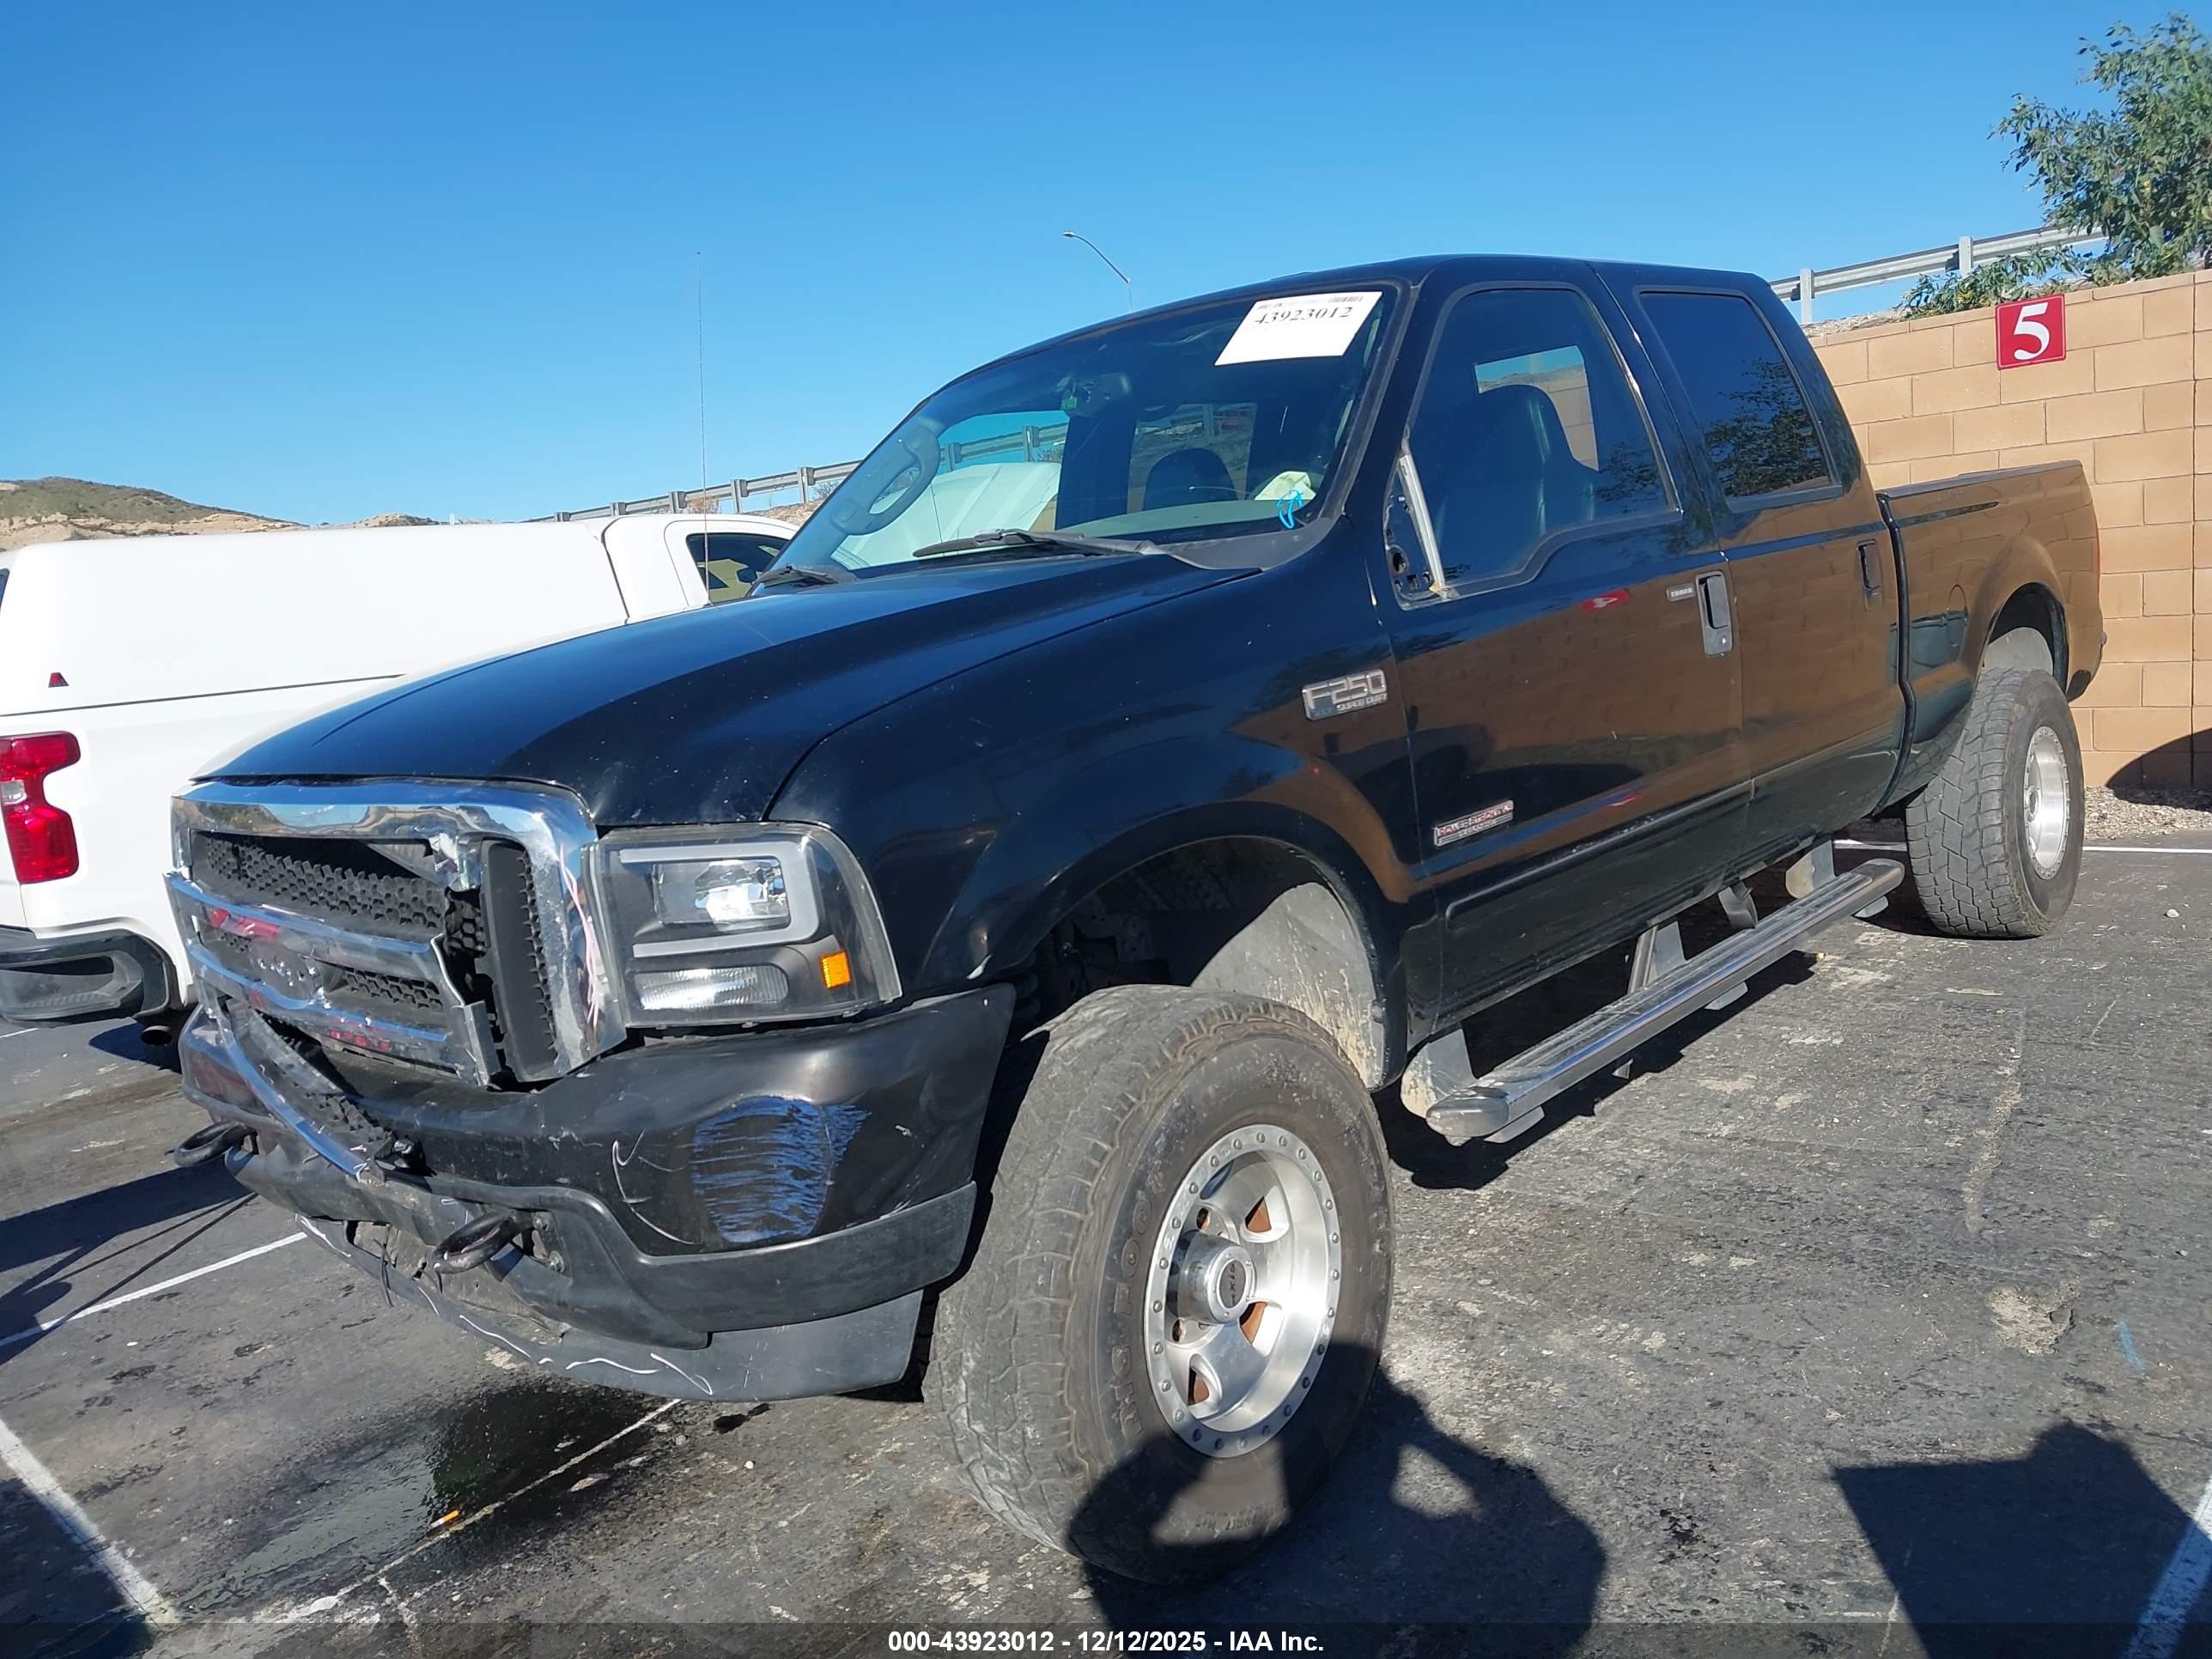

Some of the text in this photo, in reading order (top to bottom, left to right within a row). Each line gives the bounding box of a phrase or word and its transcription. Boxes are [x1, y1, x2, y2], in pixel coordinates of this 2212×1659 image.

[1255, 307, 1353, 325] 43923012
[2014, 302, 2050, 361] 5
[1111, 1345, 1144, 1437] BIG
